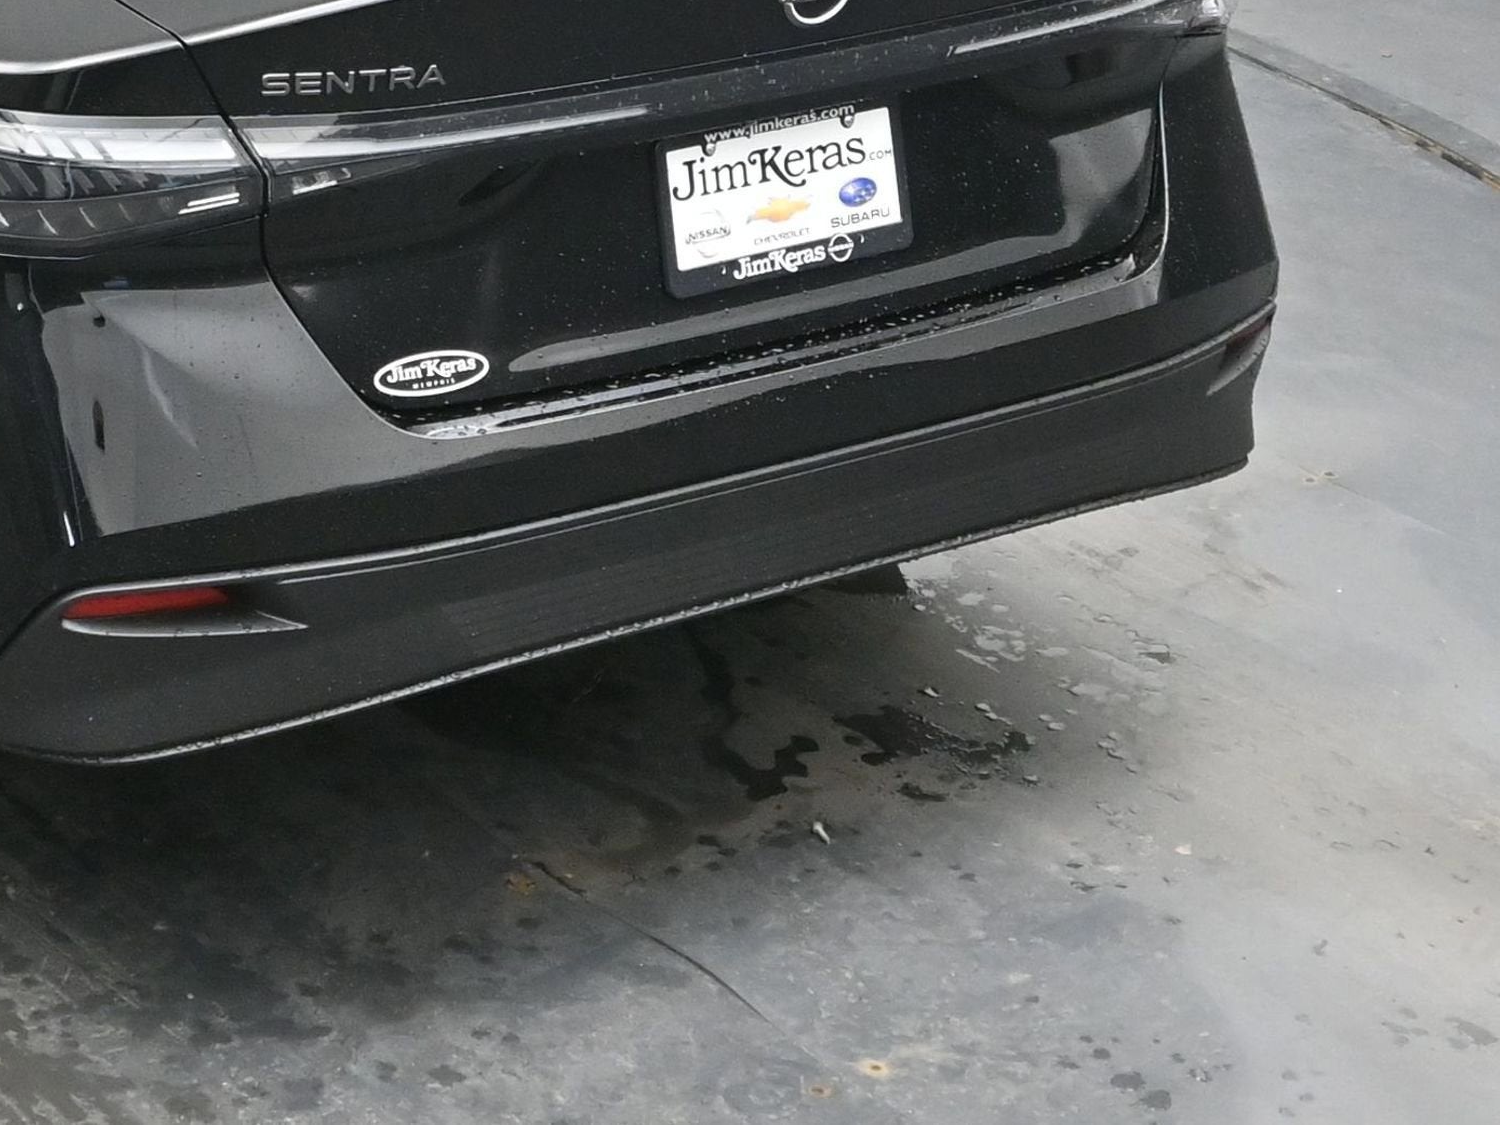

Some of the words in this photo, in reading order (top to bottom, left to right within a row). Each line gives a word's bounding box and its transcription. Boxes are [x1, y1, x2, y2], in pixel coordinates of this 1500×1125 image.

[261, 64, 446, 96] SENTRA
[703, 104, 855, 143] www.jimkeras.com
[830, 206, 890, 228] SUBARU
[687, 225, 728, 241] NISSAN
